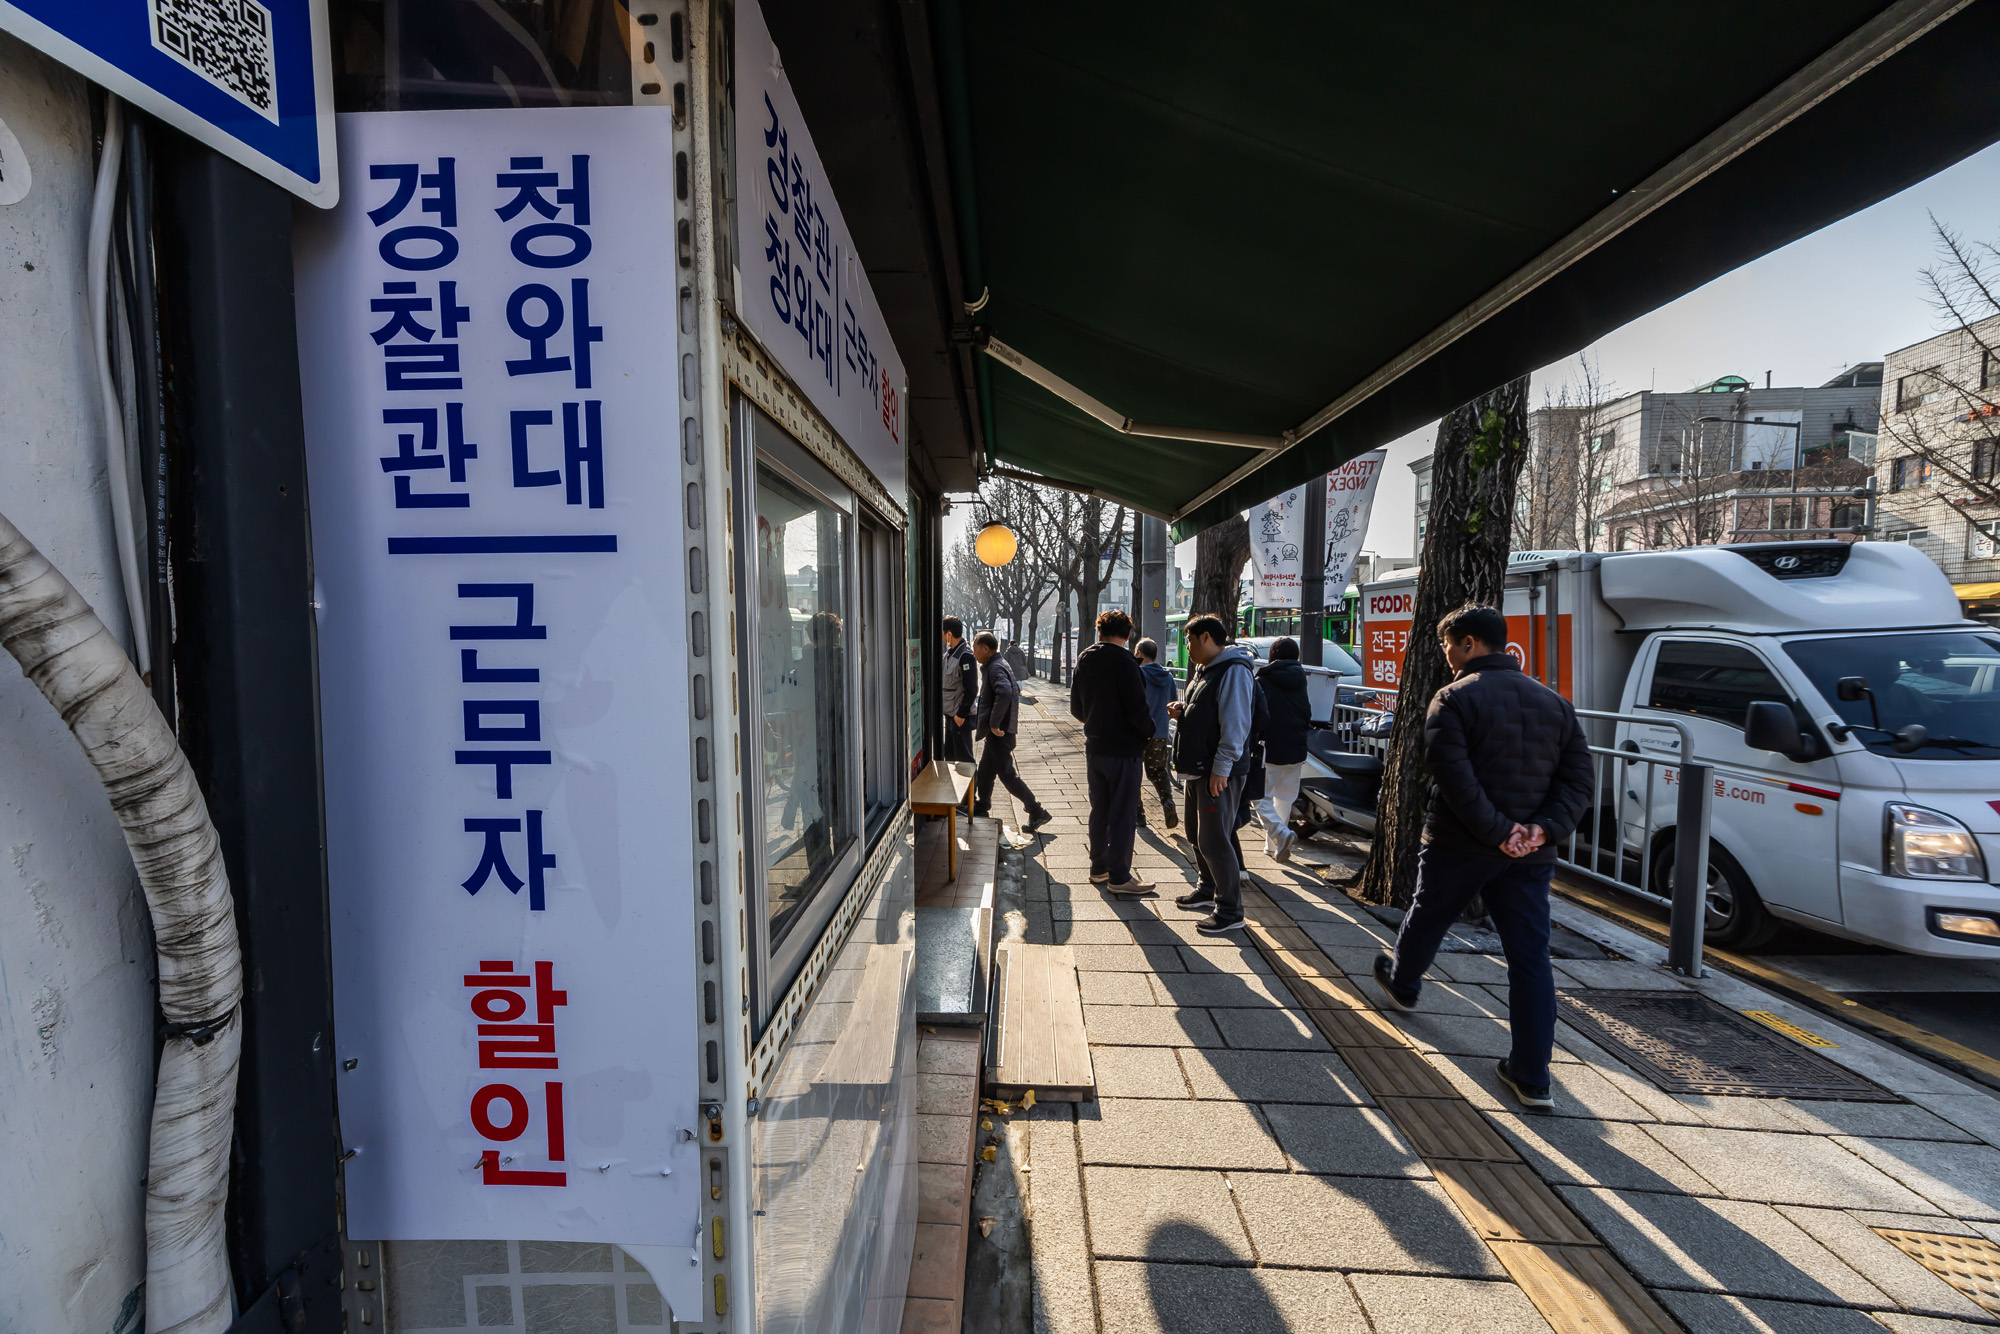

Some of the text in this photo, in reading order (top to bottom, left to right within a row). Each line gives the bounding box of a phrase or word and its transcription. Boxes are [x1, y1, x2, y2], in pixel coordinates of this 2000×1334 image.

[764, 89, 832, 298] 경찰관
[366, 156, 478, 510] 경찰관
[764, 213, 900, 446] 청와대 근무자 할인
[449, 154, 605, 1188] 청와대 근무자 할인
[1370, 594, 1416, 615] FOODR
[1372, 630, 1396, 653] 전국
